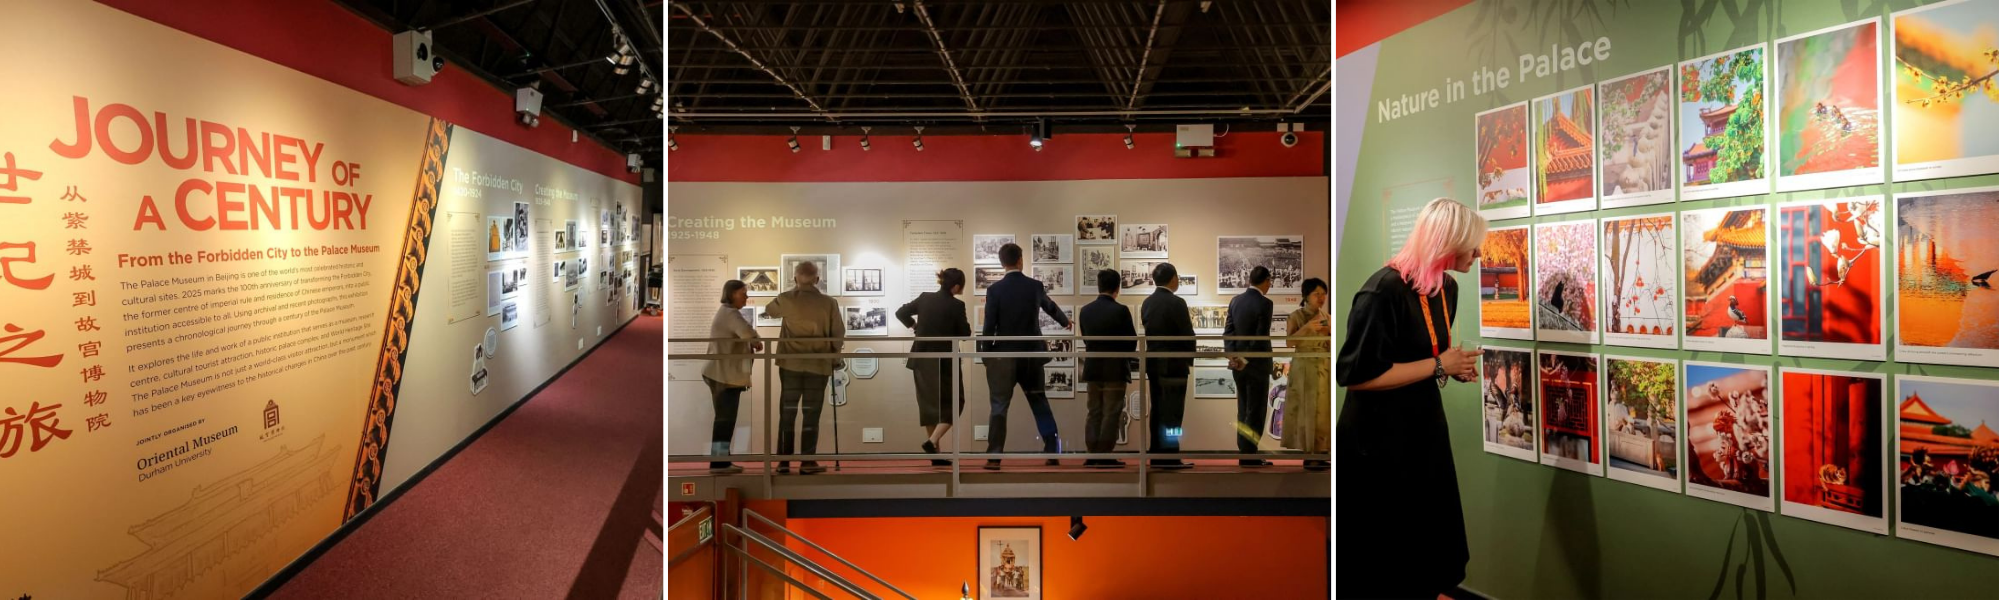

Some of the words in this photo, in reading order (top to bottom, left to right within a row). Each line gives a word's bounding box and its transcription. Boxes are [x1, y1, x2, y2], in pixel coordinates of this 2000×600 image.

[1378, 87, 1440, 123] Nature
[1447, 77, 1465, 103] in
[1472, 65, 1510, 96] the
[1519, 36, 1611, 83] Palace
[49, 95, 325, 183] JOURNEY
[332, 160, 361, 188] OF
[453, 167, 470, 184] The
[472, 171, 509, 190] Forbidden
[510, 179, 524, 195] City
[535, 183, 555, 199] Creating
[133, 195, 167, 231] A
[174, 178, 373, 231] CENTURY
[668, 215, 735, 230] Creating
[740, 215, 766, 228] the
[771, 216, 837, 228] Museum
[668, 230, 720, 239] 1925-1948
[118, 253, 164, 268] From
[168, 251, 193, 265] the
[197, 248, 263, 263] Forbidden
[266, 247, 288, 260] City
[291, 247, 301, 258] to
[304, 245, 319, 256] the
[321, 245, 348, 255] Palace
[350, 244, 380, 254] Museum
[121, 282, 138, 290] The
[141, 280, 169, 288] Palace
[172, 277, 204, 285] Museum
[216, 273, 239, 282] Beijing
[280, 267, 298, 275] world's
[122, 295, 156, 306] cultural
[159, 293, 178, 301] sites.
[182, 290, 201, 299] 2025
[204, 287, 225, 296] marks
[260, 278, 292, 289] anniversary
[300, 274, 331, 284] transforming
[60, 185, 112, 432] 从紫禁城到故宫博物院
[123, 312, 139, 321] the
[142, 309, 171, 319] former
[174, 306, 198, 314] centre
[201, 301, 208, 310] of
[211, 298, 238, 309] imperial
[267, 291, 293, 300] residence
[302, 287, 320, 295] Chinese
[125, 323, 170, 337] institution
[172, 316, 212, 328] accessible
[234, 309, 252, 318] Using
[254, 306, 277, 314] archival
[126, 339, 165, 354] presents
[175, 327, 226, 342] chronological
[227, 323, 252, 333] journey
[253, 317, 277, 327] through
[283, 312, 304, 322] century
[129, 365, 135, 373] It
[138, 358, 174, 370] explores
[177, 354, 190, 363] the
[192, 350, 203, 359] life
[206, 346, 219, 356] and
[221, 342, 237, 352] work
[239, 338, 246, 347] of
[253, 335, 271, 345] public
[273, 329, 300, 339] institution
[130, 375, 161, 388] centre,
[163, 367, 193, 380] cultural
[195, 360, 219, 371] tourist
[256, 346, 277, 356] historic
[278, 340, 297, 351] palace
[131, 392, 149, 402] The
[151, 385, 179, 397] Palace
[180, 376, 213, 389] Museum
[221, 369, 233, 377] not
[235, 365, 247, 375] just
[253, 355, 287, 368] world-class
[288, 350, 304, 359] visitor
[133, 407, 149, 418] has
[151, 400, 173, 412] been
[182, 393, 195, 404] key
[197, 382, 236, 398] eyewitness
[245, 375, 256, 384] the
[257, 368, 284, 379] historical
[285, 361, 307, 371] changes
[313, 355, 327, 363] China
[136, 433, 161, 446] JOINTLY
[164, 421, 197, 437] ORGANISED
[137, 441, 190, 471] Oriental
[192, 425, 238, 449] Museum
[138, 463, 173, 482] Durham
[174, 447, 212, 468] University
